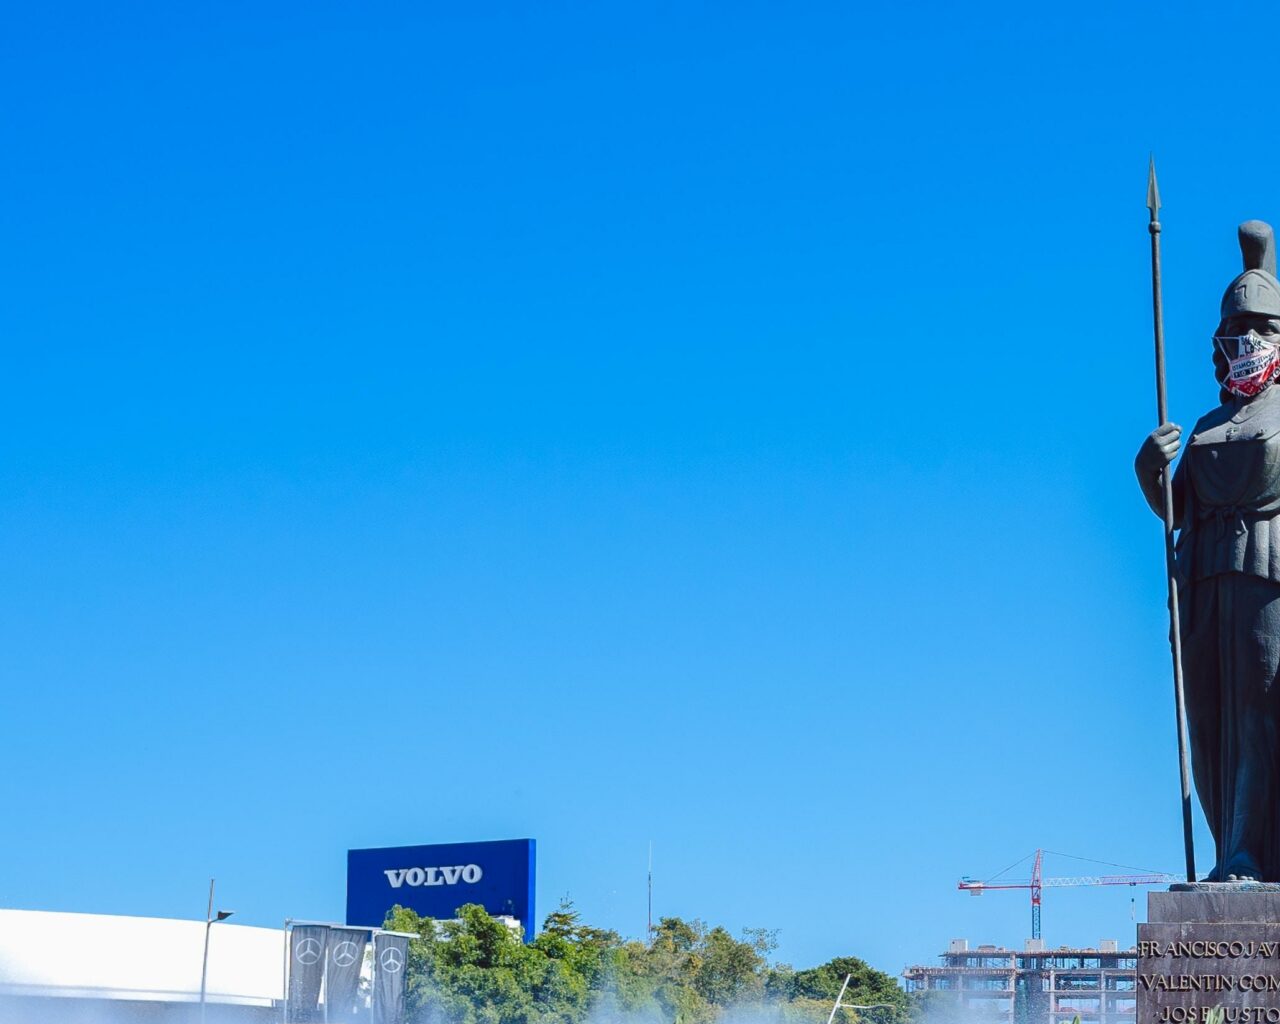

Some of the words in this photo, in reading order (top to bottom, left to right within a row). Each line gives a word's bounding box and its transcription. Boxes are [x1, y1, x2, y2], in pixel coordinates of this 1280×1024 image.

[384, 864, 483, 888] VOLVO
[1139, 940, 1244, 959] FRANCISCO
[1139, 974, 1235, 992] VALENTIN
[1219, 1007, 1280, 1024] USTO
